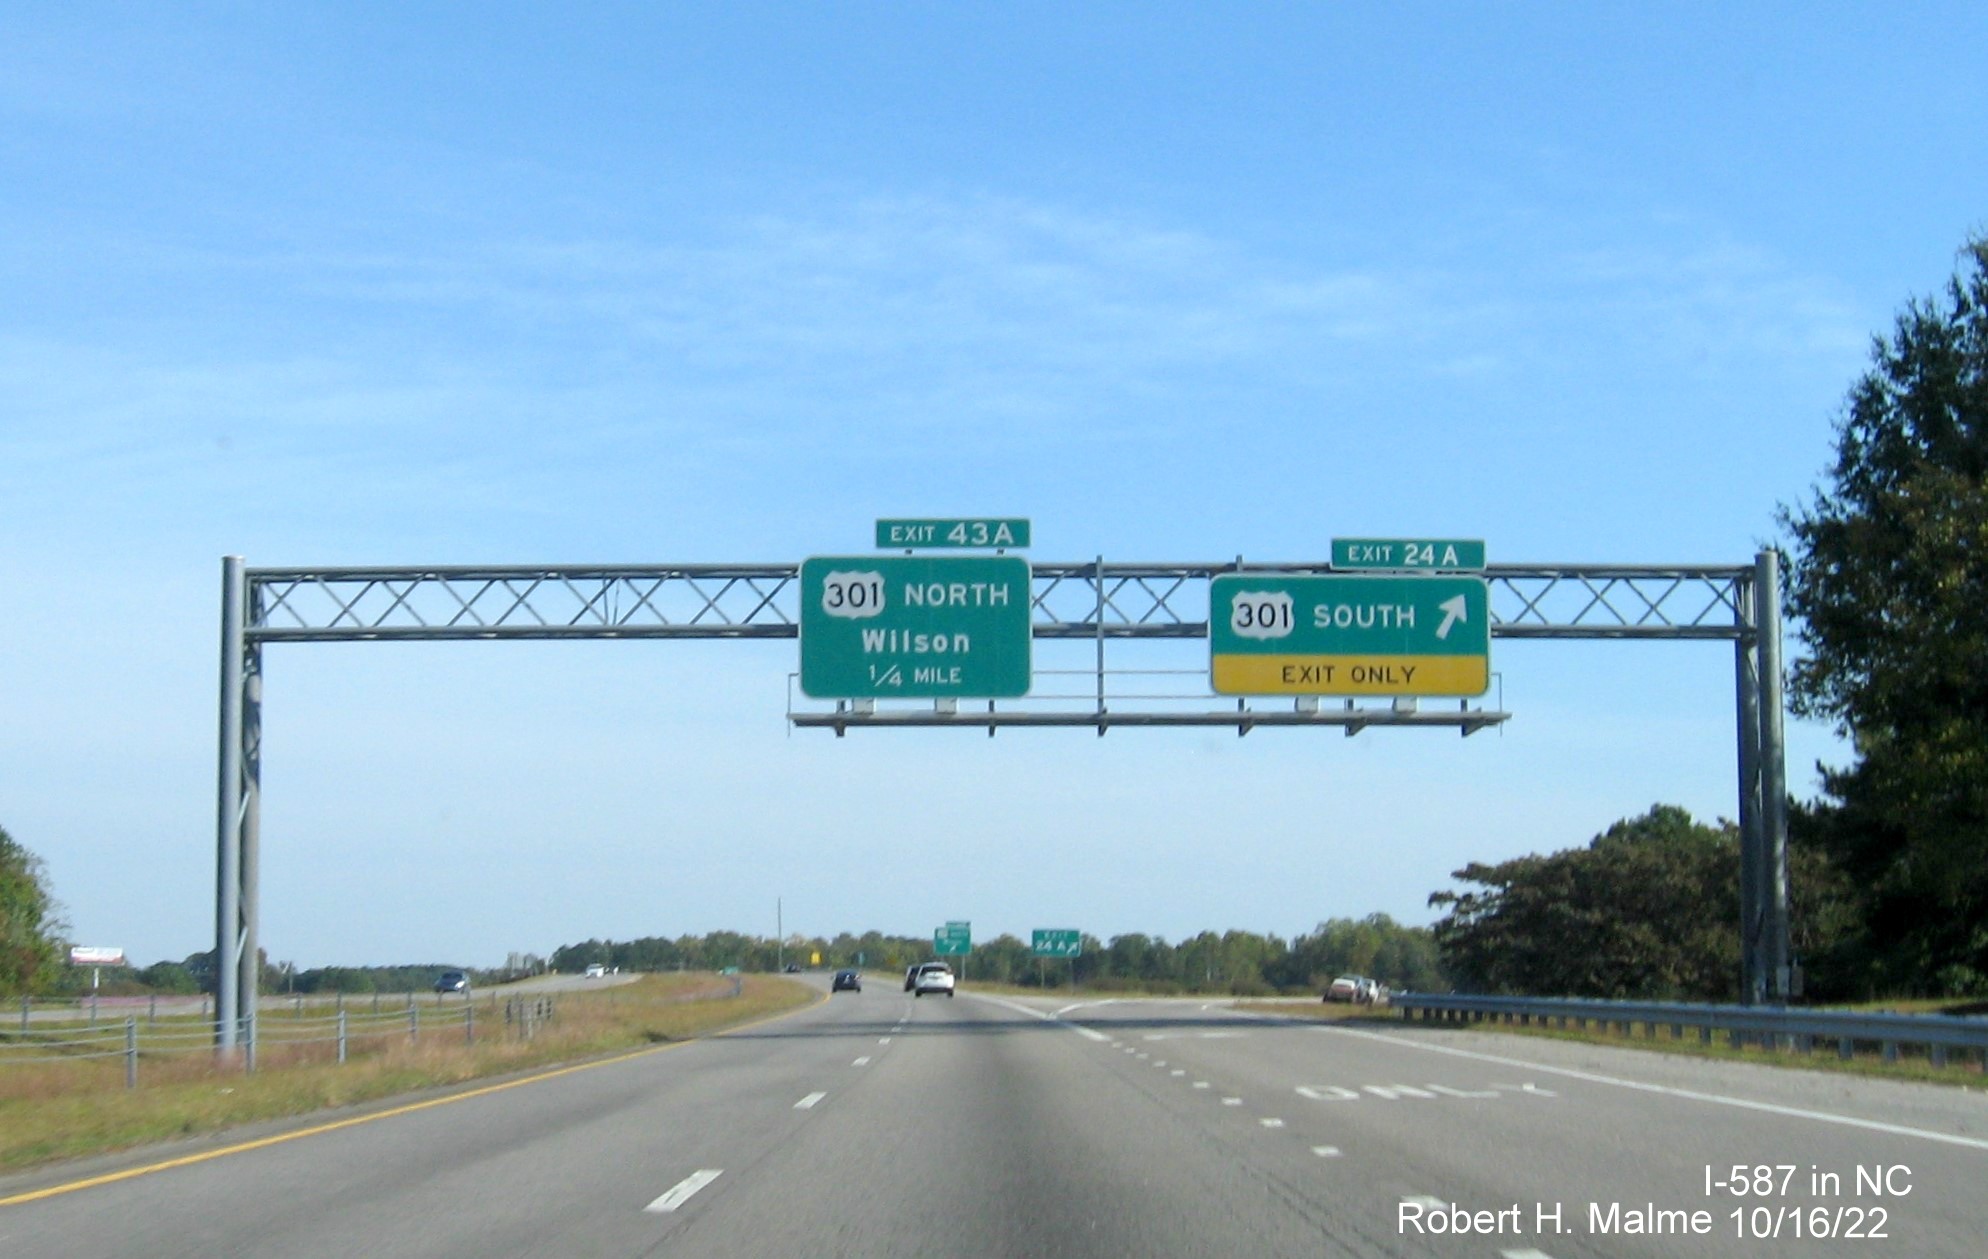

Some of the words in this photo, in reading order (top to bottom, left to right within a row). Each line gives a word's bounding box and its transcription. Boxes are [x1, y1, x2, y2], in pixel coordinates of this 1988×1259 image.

[891, 526, 935, 542] EXIT
[947, 522, 1014, 545] 43A
[1348, 546, 1391, 561] EXIT
[1404, 543, 1434, 565] 24
[828, 582, 878, 608] 301
[904, 583, 1009, 606] NORTH
[1236, 603, 1289, 628] 301
[1314, 605, 1415, 628] SOUTH
[862, 629, 969, 653] Wilson
[869, 665, 902, 687] 1/4
[914, 668, 962, 683] MILE
[1282, 666, 1335, 683] EXIT
[1351, 666, 1416, 683] ONLY
